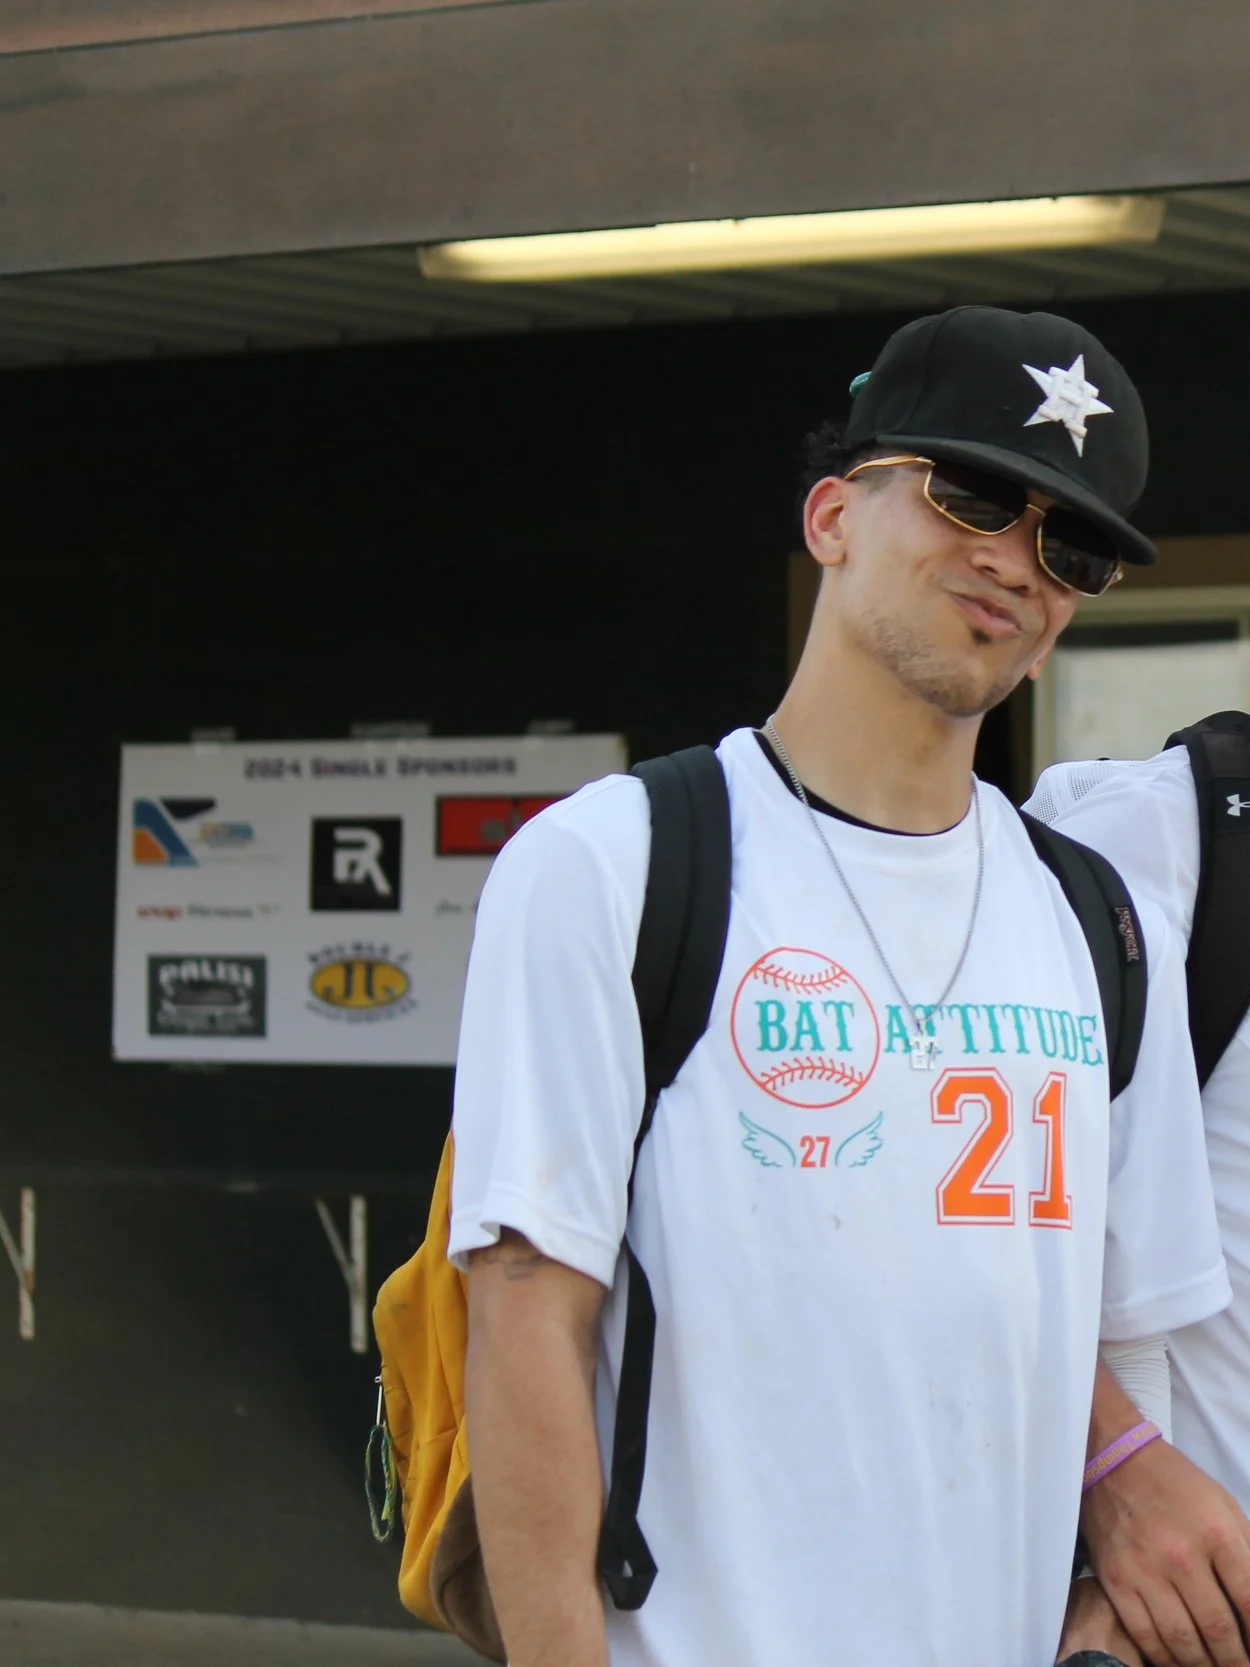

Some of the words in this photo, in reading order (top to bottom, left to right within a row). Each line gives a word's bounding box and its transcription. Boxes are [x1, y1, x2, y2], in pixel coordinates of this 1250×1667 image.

[245, 759, 302, 780] 2024
[755, 1000, 854, 1052] BAT
[884, 1004, 1104, 1066] ATTITUDE
[800, 1136, 831, 1169] 27
[930, 1067, 1073, 1230] 21
